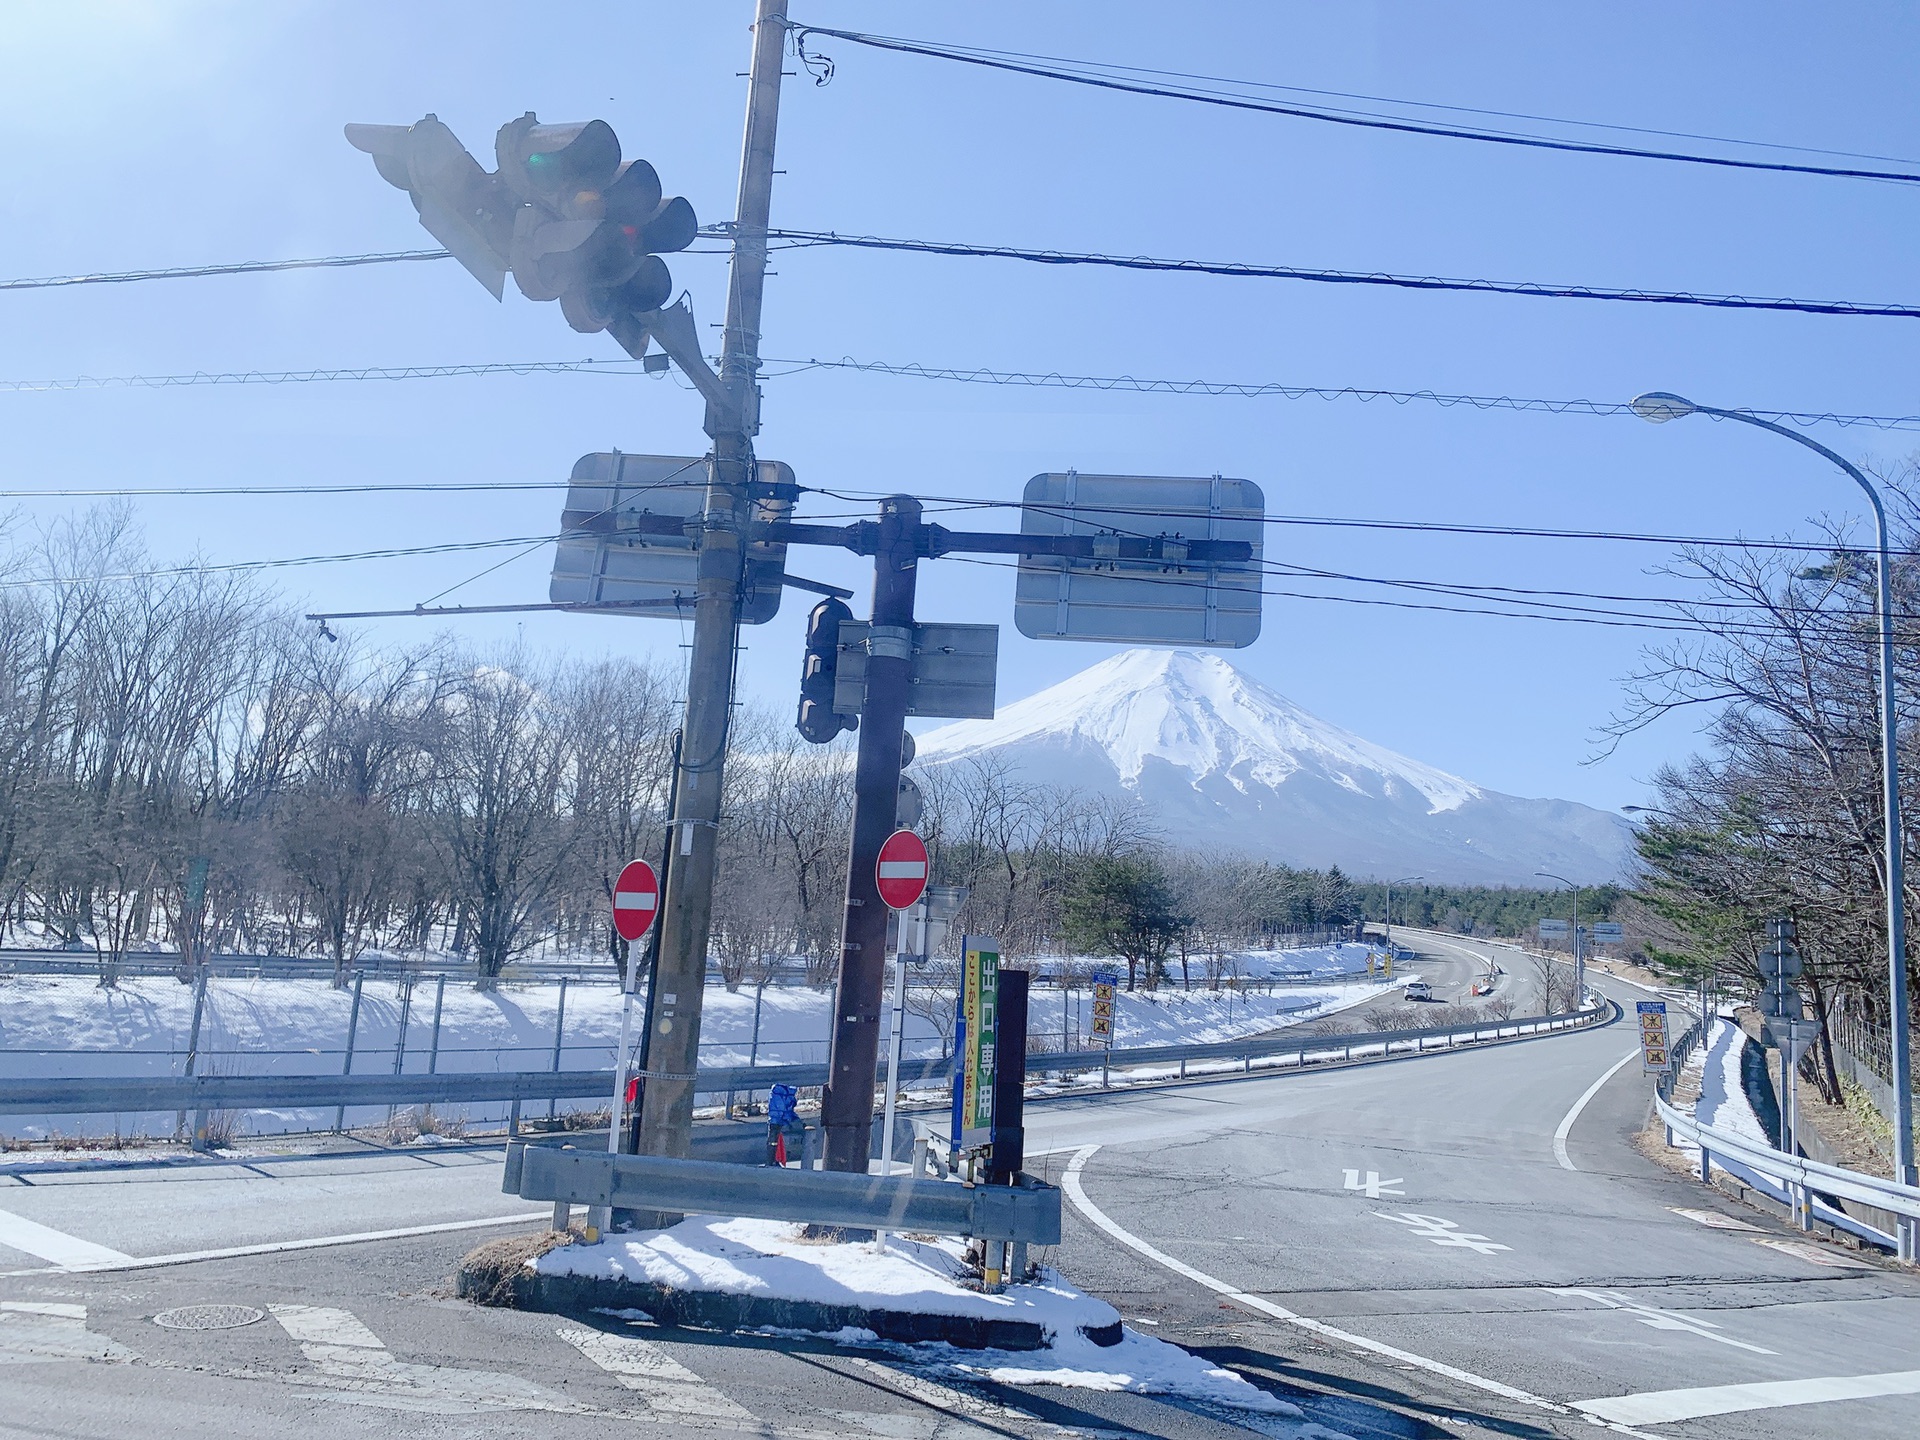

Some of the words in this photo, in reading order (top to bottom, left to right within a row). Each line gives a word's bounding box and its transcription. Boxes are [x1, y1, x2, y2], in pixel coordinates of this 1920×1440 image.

[964, 955, 976, 1125] ここからは入れません
[979, 959, 996, 1119] 出口専用
